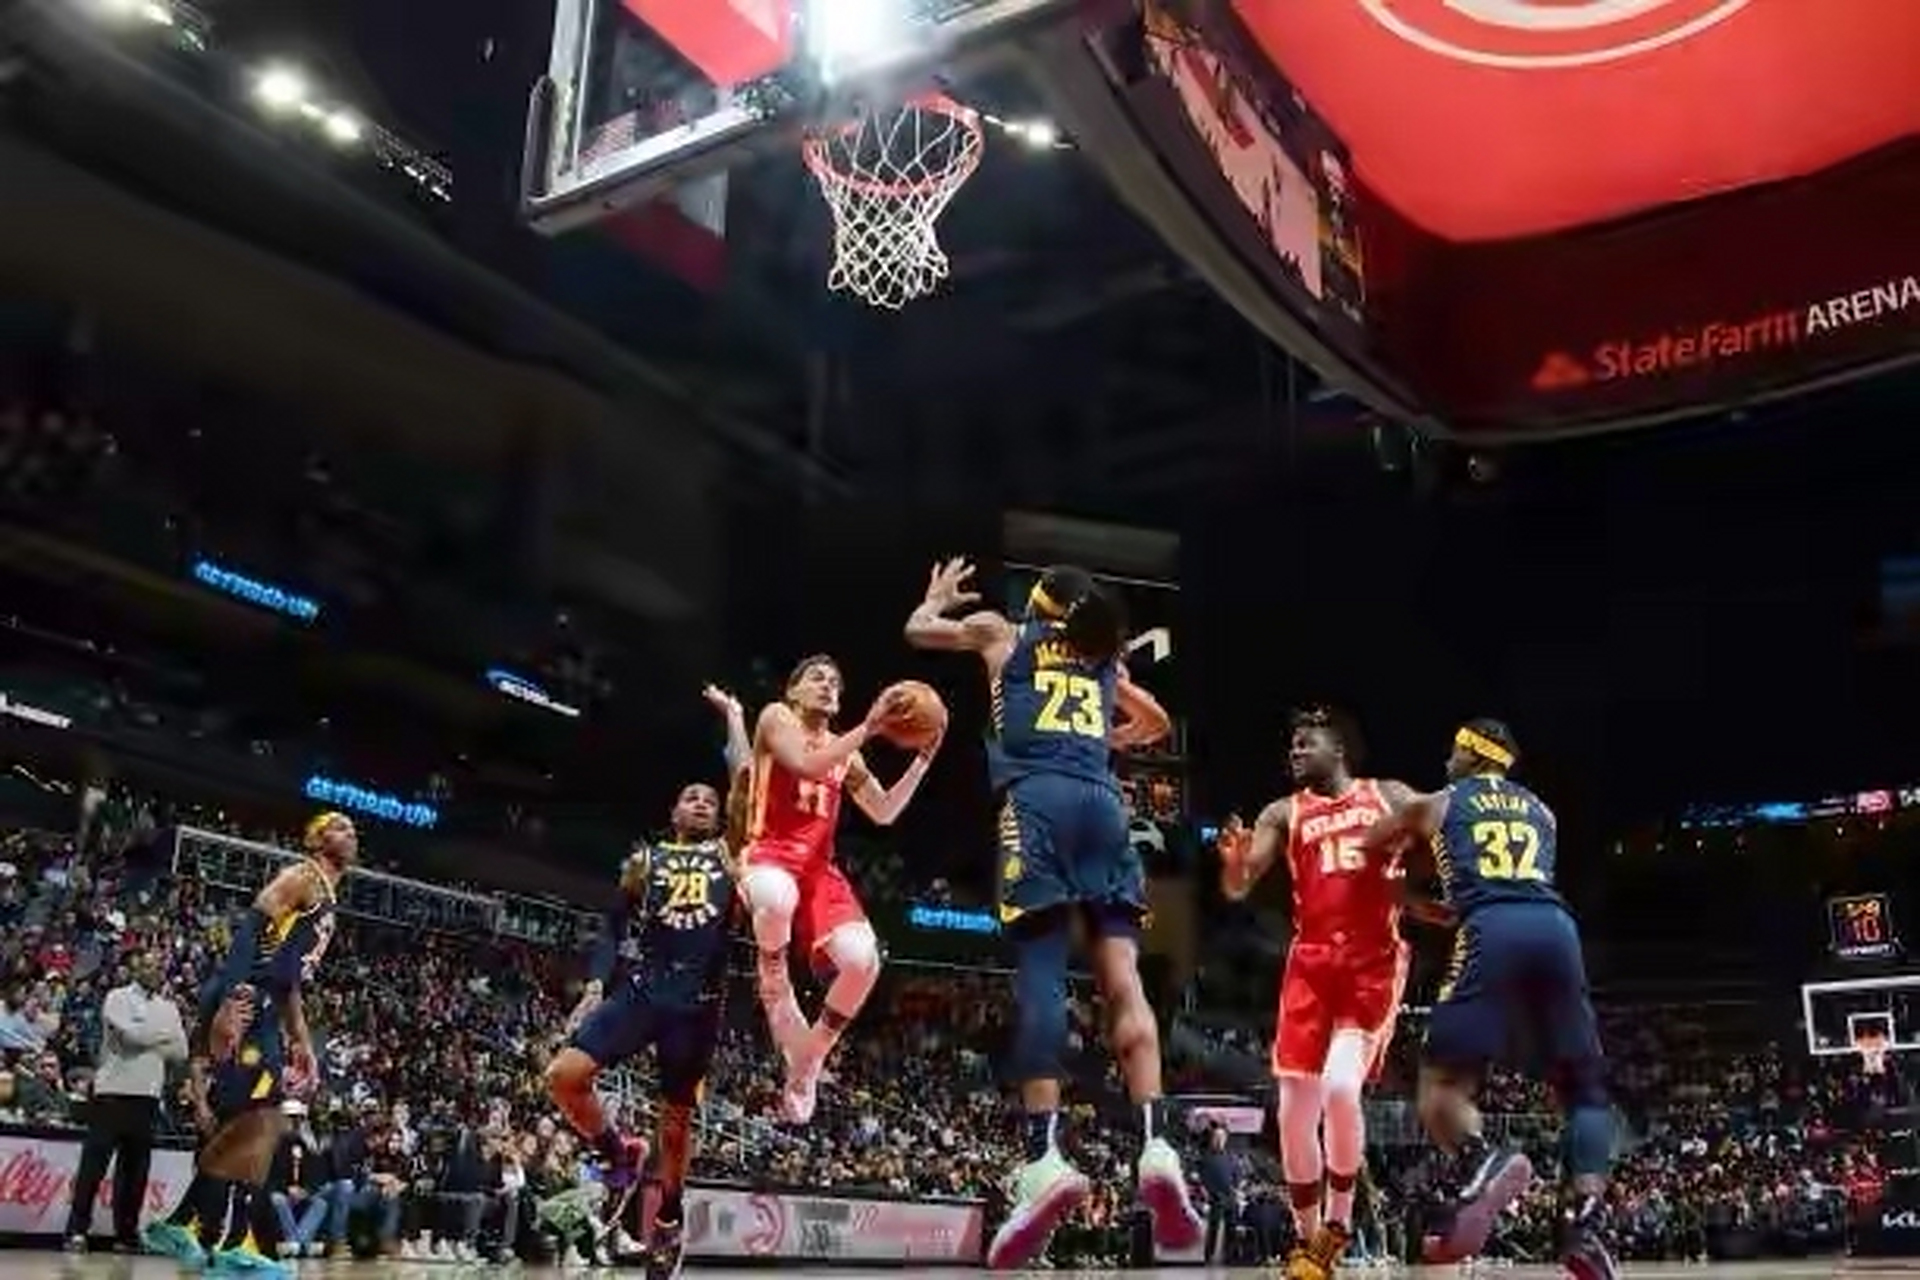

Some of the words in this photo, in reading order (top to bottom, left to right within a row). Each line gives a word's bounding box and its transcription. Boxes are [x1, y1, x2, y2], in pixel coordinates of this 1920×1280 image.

[1806, 275, 1920, 335] ARENA
[1034, 670, 1104, 738] 23
[1319, 835, 1368, 873] 15
[1473, 820, 1545, 880] 32
